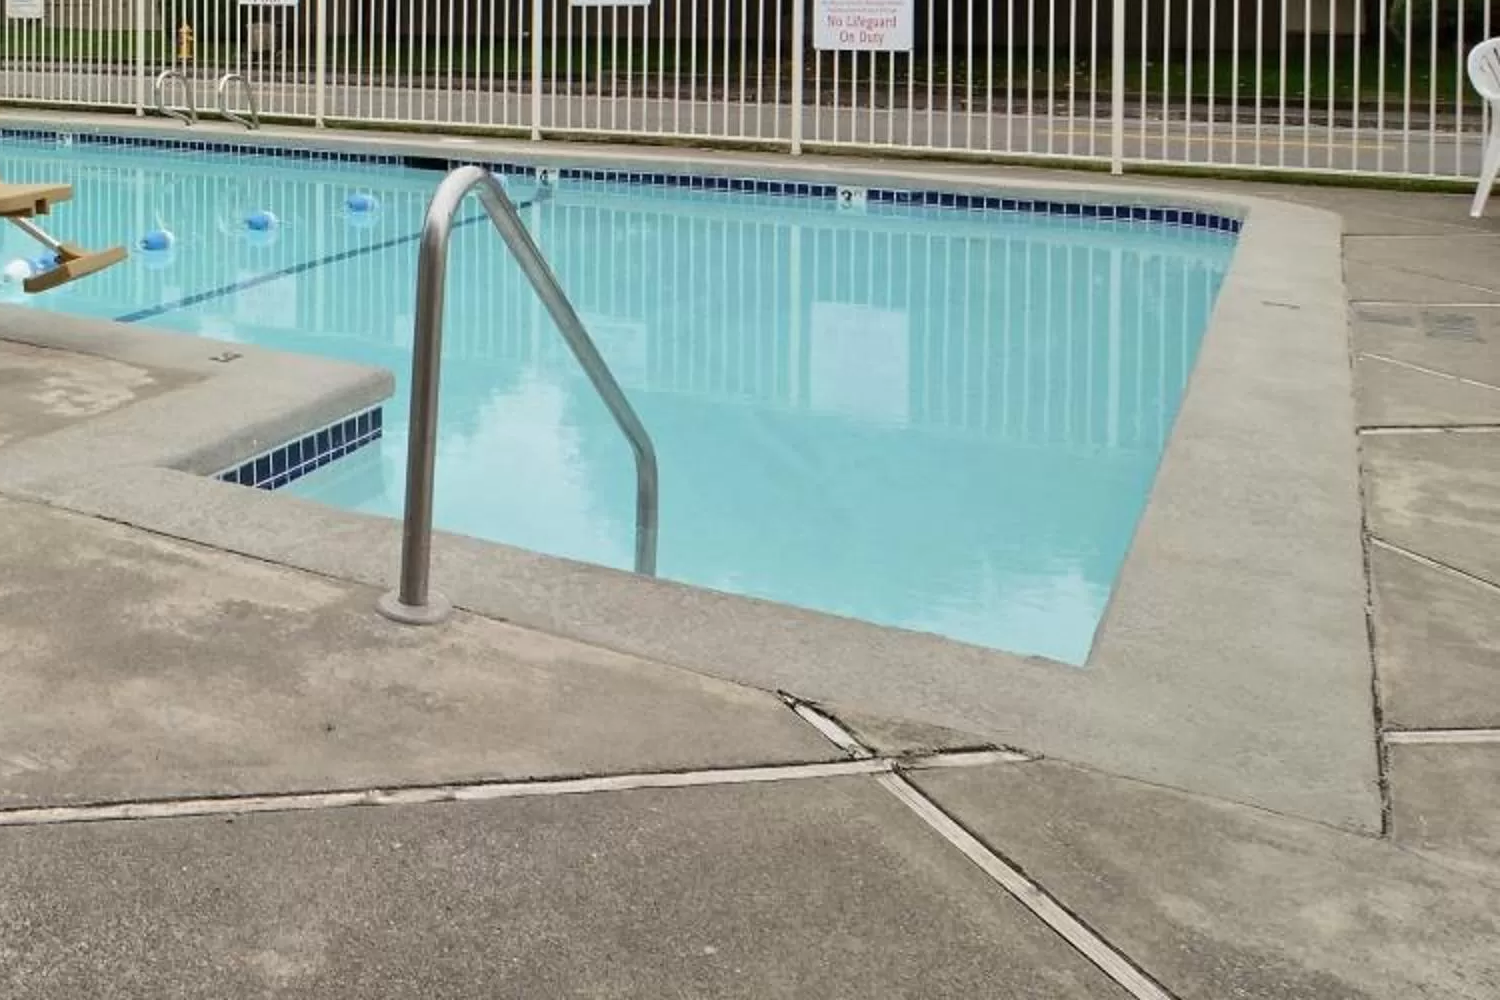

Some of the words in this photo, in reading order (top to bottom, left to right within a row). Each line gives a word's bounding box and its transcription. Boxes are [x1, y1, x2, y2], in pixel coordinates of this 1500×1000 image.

[827, 15, 843, 28] No
[846, 15, 897, 30] Lifeguard
[839, 31, 855, 42] On
[859, 31, 885, 44] Duty
